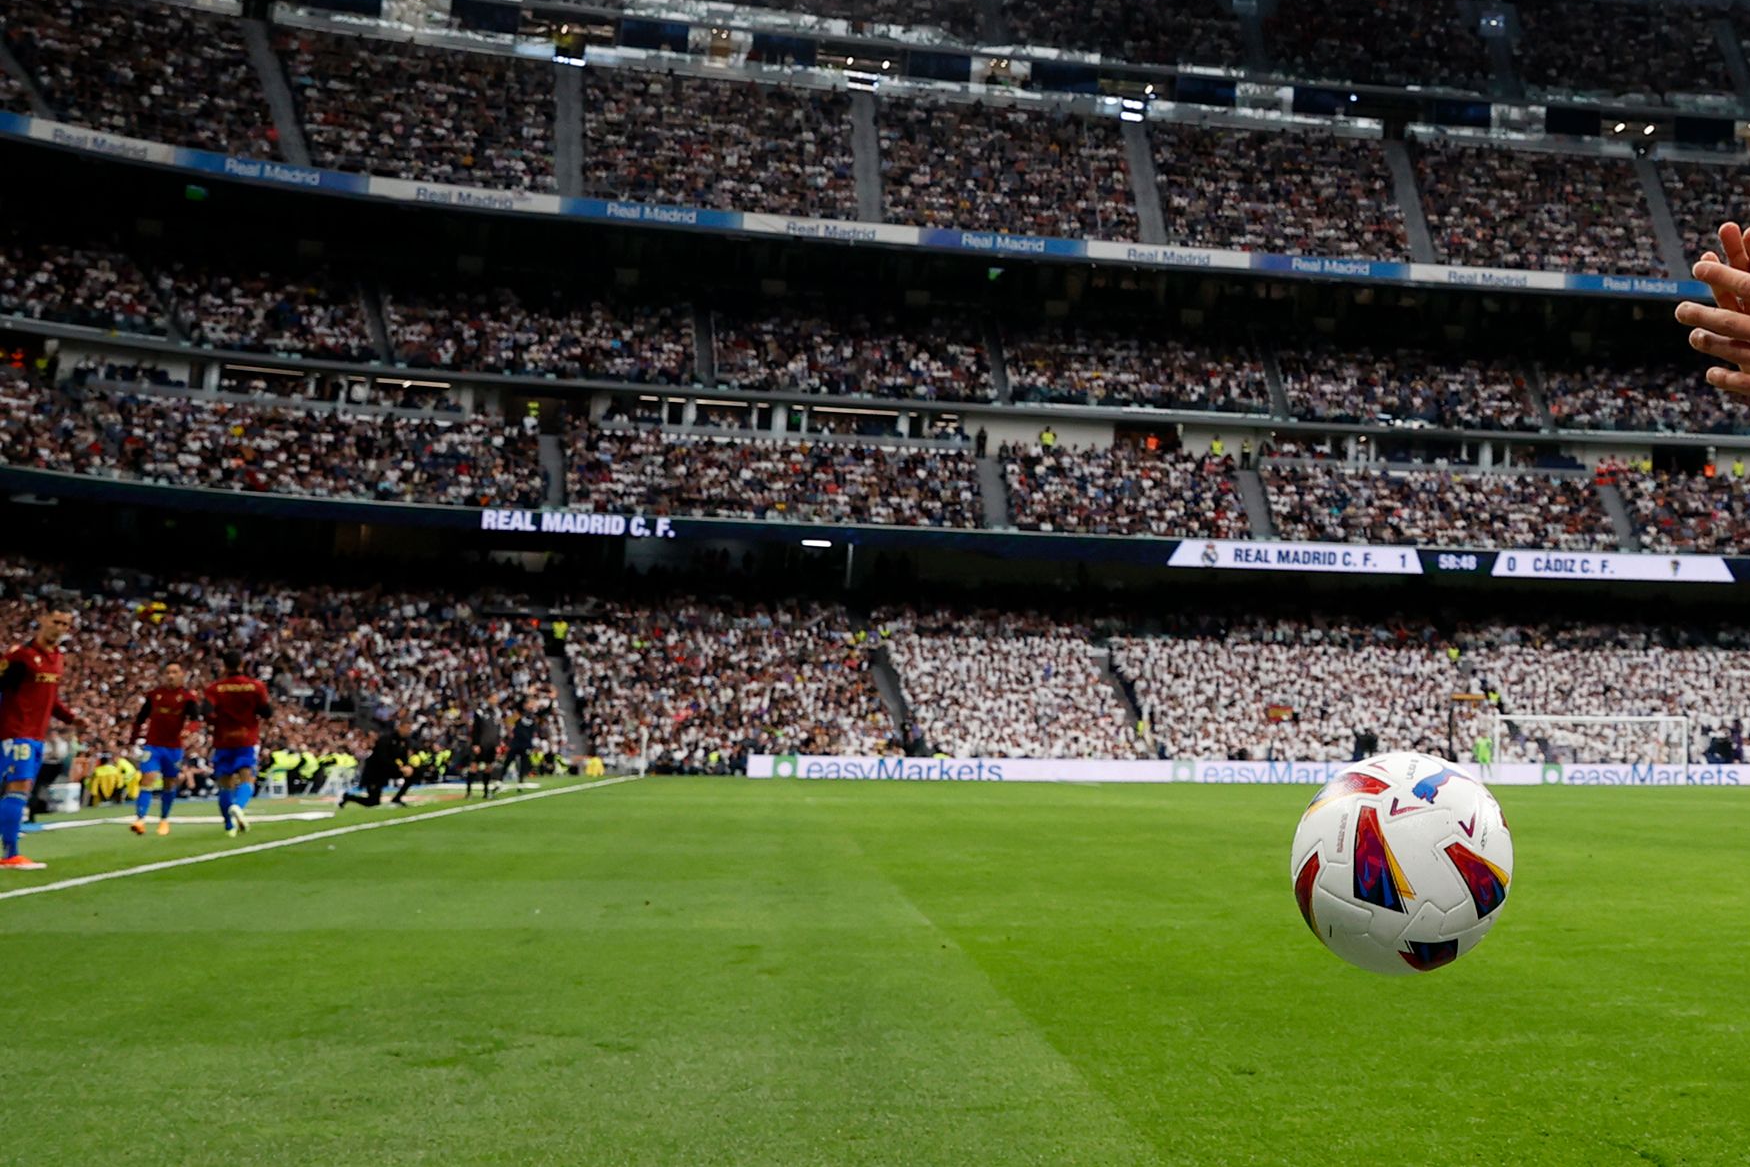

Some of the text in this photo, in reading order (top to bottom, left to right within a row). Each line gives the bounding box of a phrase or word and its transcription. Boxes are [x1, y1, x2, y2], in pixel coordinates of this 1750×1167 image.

[606, 201, 698, 224] Real Madrid
[961, 232, 1046, 253] Real Madrid
[1127, 248, 1211, 266] Real Madrid
[1291, 257, 1371, 276] Real Madrid
[1449, 271, 1529, 287] Real Madrid
[1602, 277, 1679, 294] Real Madrid
[481, 509, 676, 538] REAL MADRID C. F.
[1233, 548, 1407, 569] REAL MADRID C. F. 1
[1507, 554, 1615, 575] 0 CÁDIZ C. F.
[806, 759, 1004, 781] easyMarkets
[1203, 761, 1338, 784] easyMark
[1569, 764, 1740, 785] easyMarkets
